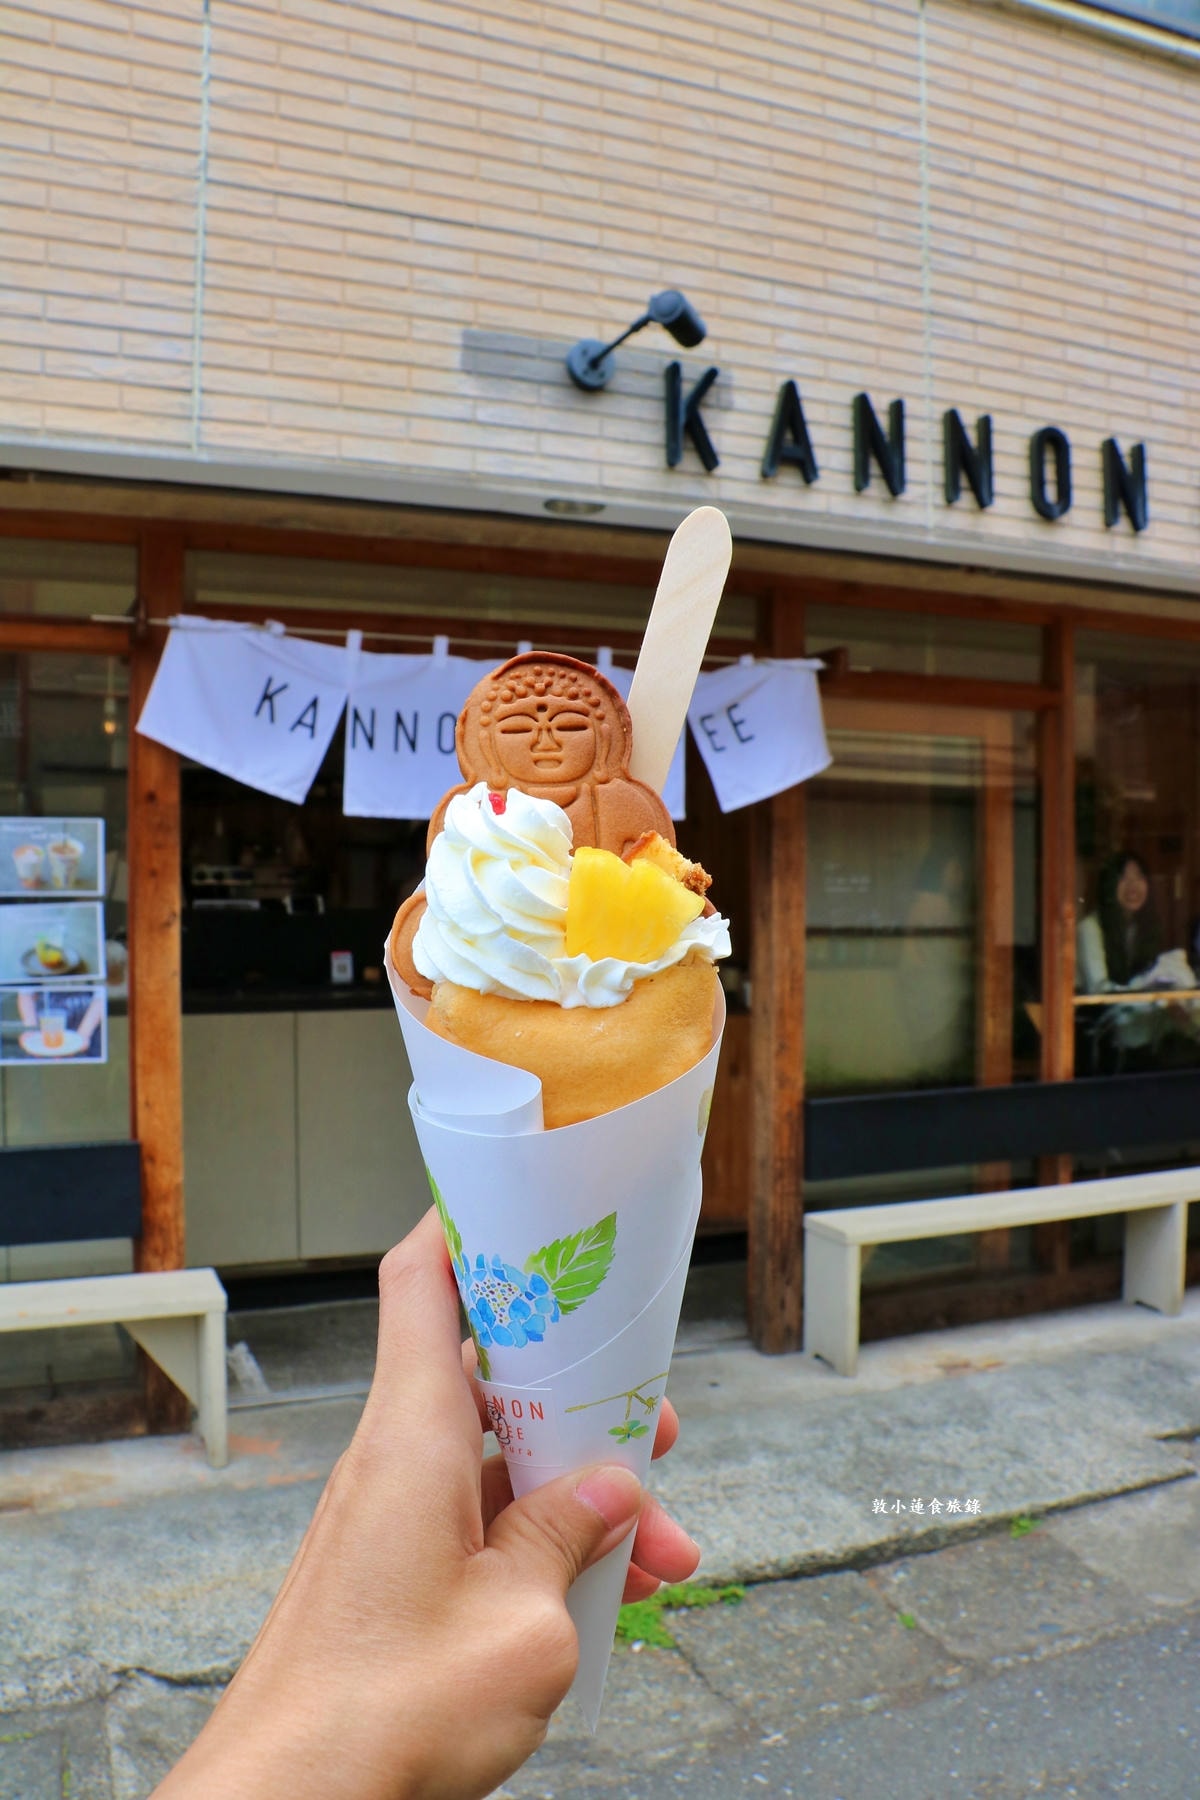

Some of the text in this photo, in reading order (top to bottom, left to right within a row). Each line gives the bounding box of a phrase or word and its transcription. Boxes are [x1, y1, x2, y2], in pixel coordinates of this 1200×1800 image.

[664, 360, 1149, 533] KANNON
[254, 676, 457, 754] KANNO
[482, 1392, 544, 1421] NON
